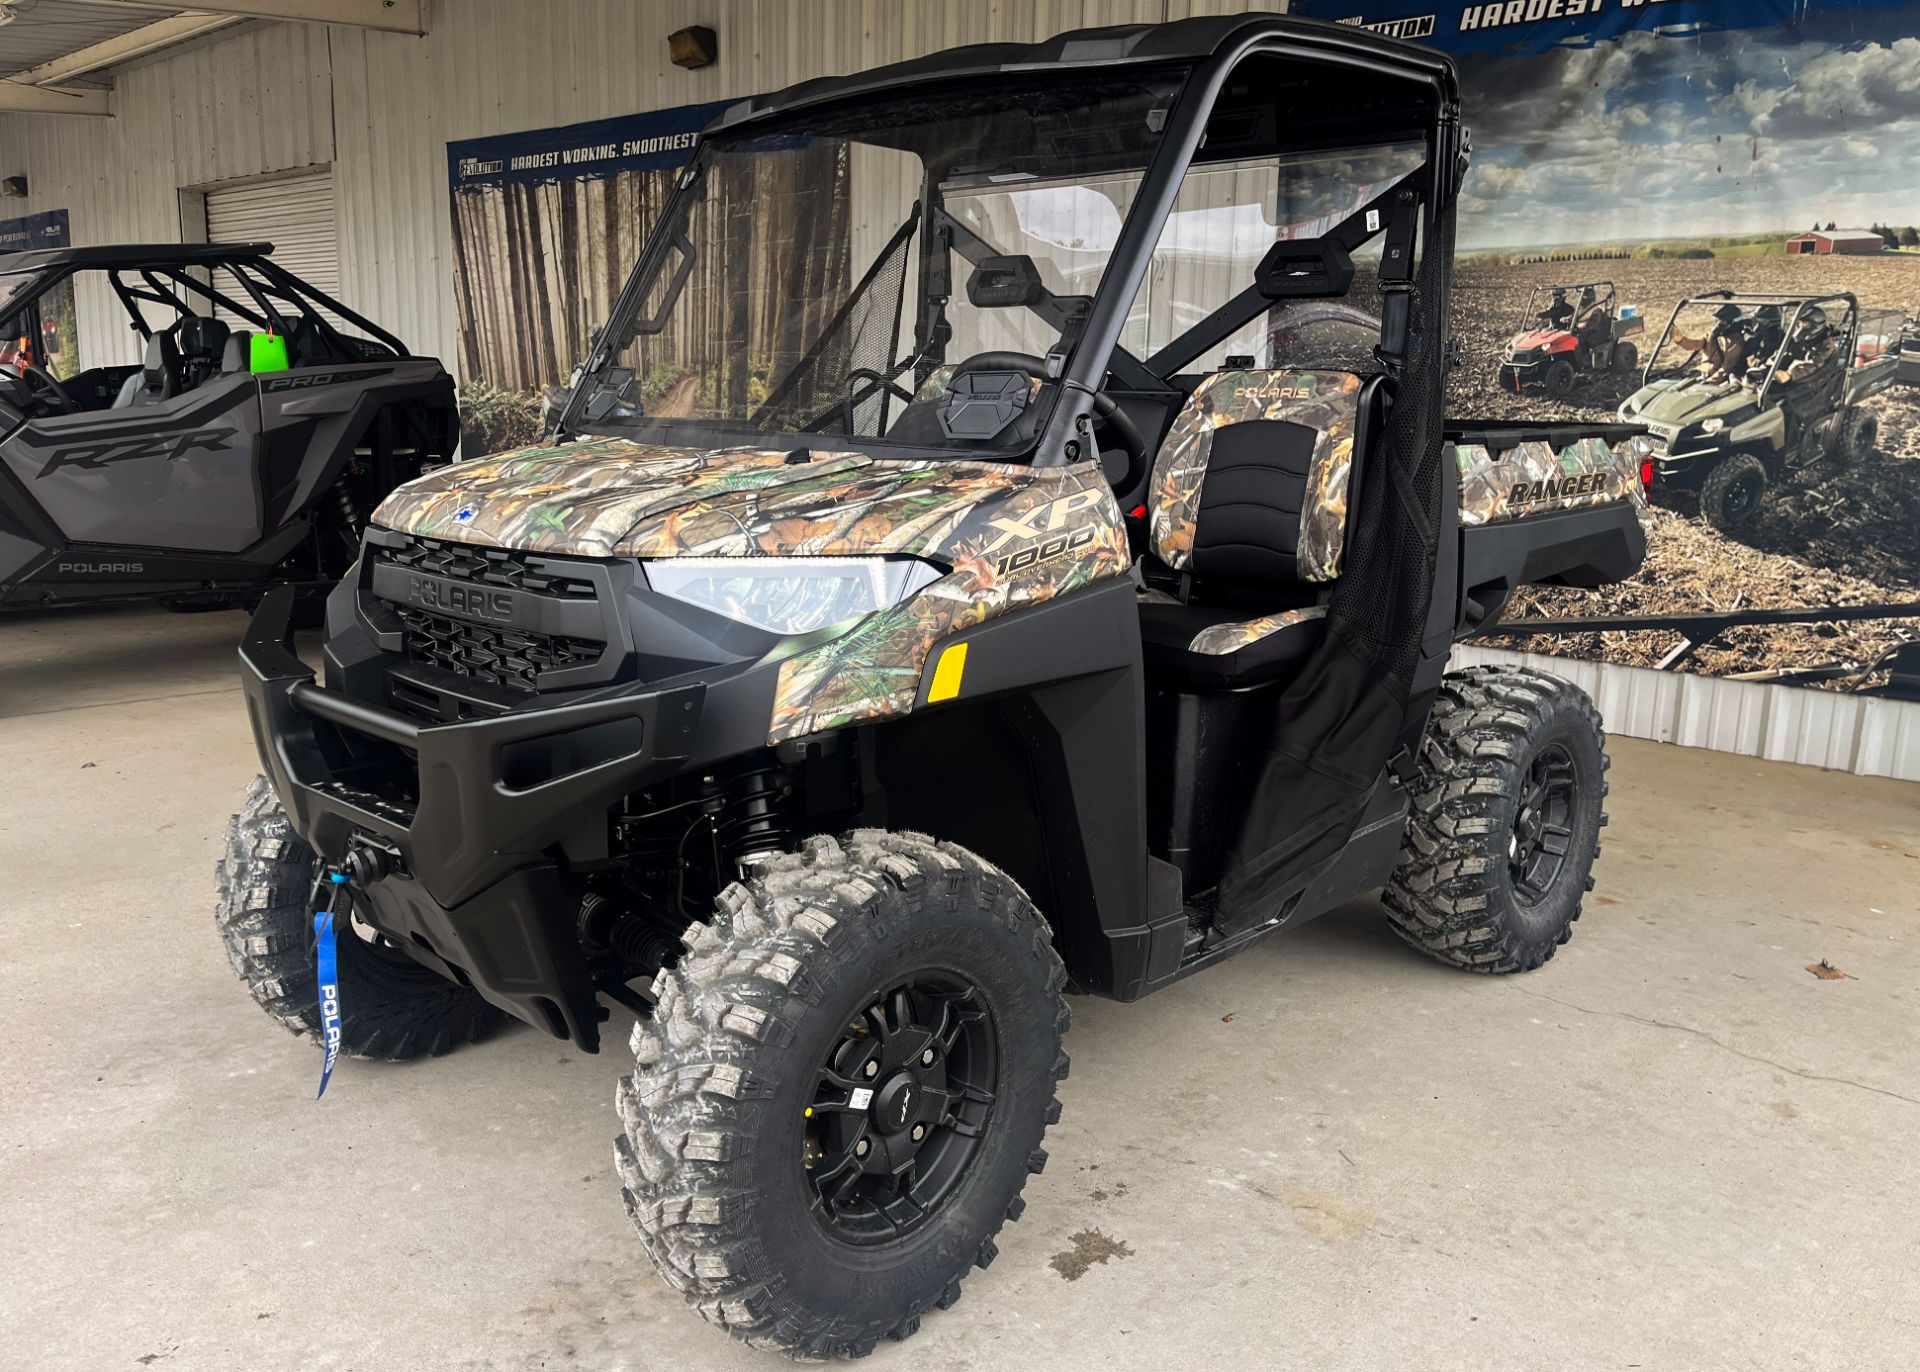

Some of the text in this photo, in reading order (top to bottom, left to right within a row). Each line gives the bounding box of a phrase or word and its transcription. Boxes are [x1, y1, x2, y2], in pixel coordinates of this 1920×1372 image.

[511, 132, 699, 171] HARDEST WORKING. SMOOTHEST
[268, 373, 334, 391] PRO
[1234, 387, 1310, 399] POLARIS
[1649, 424, 1671, 435] LARIS
[35, 427, 239, 480] RZR
[1506, 472, 1607, 507] RANGER
[970, 487, 1104, 561] XP
[59, 563, 144, 573] POLARIS
[995, 523, 1096, 579] 1000
[1023, 552, 1074, 575] OVERHEAD
[408, 577, 513, 622] POLARIS
[321, 985, 340, 1073] POLARIS
